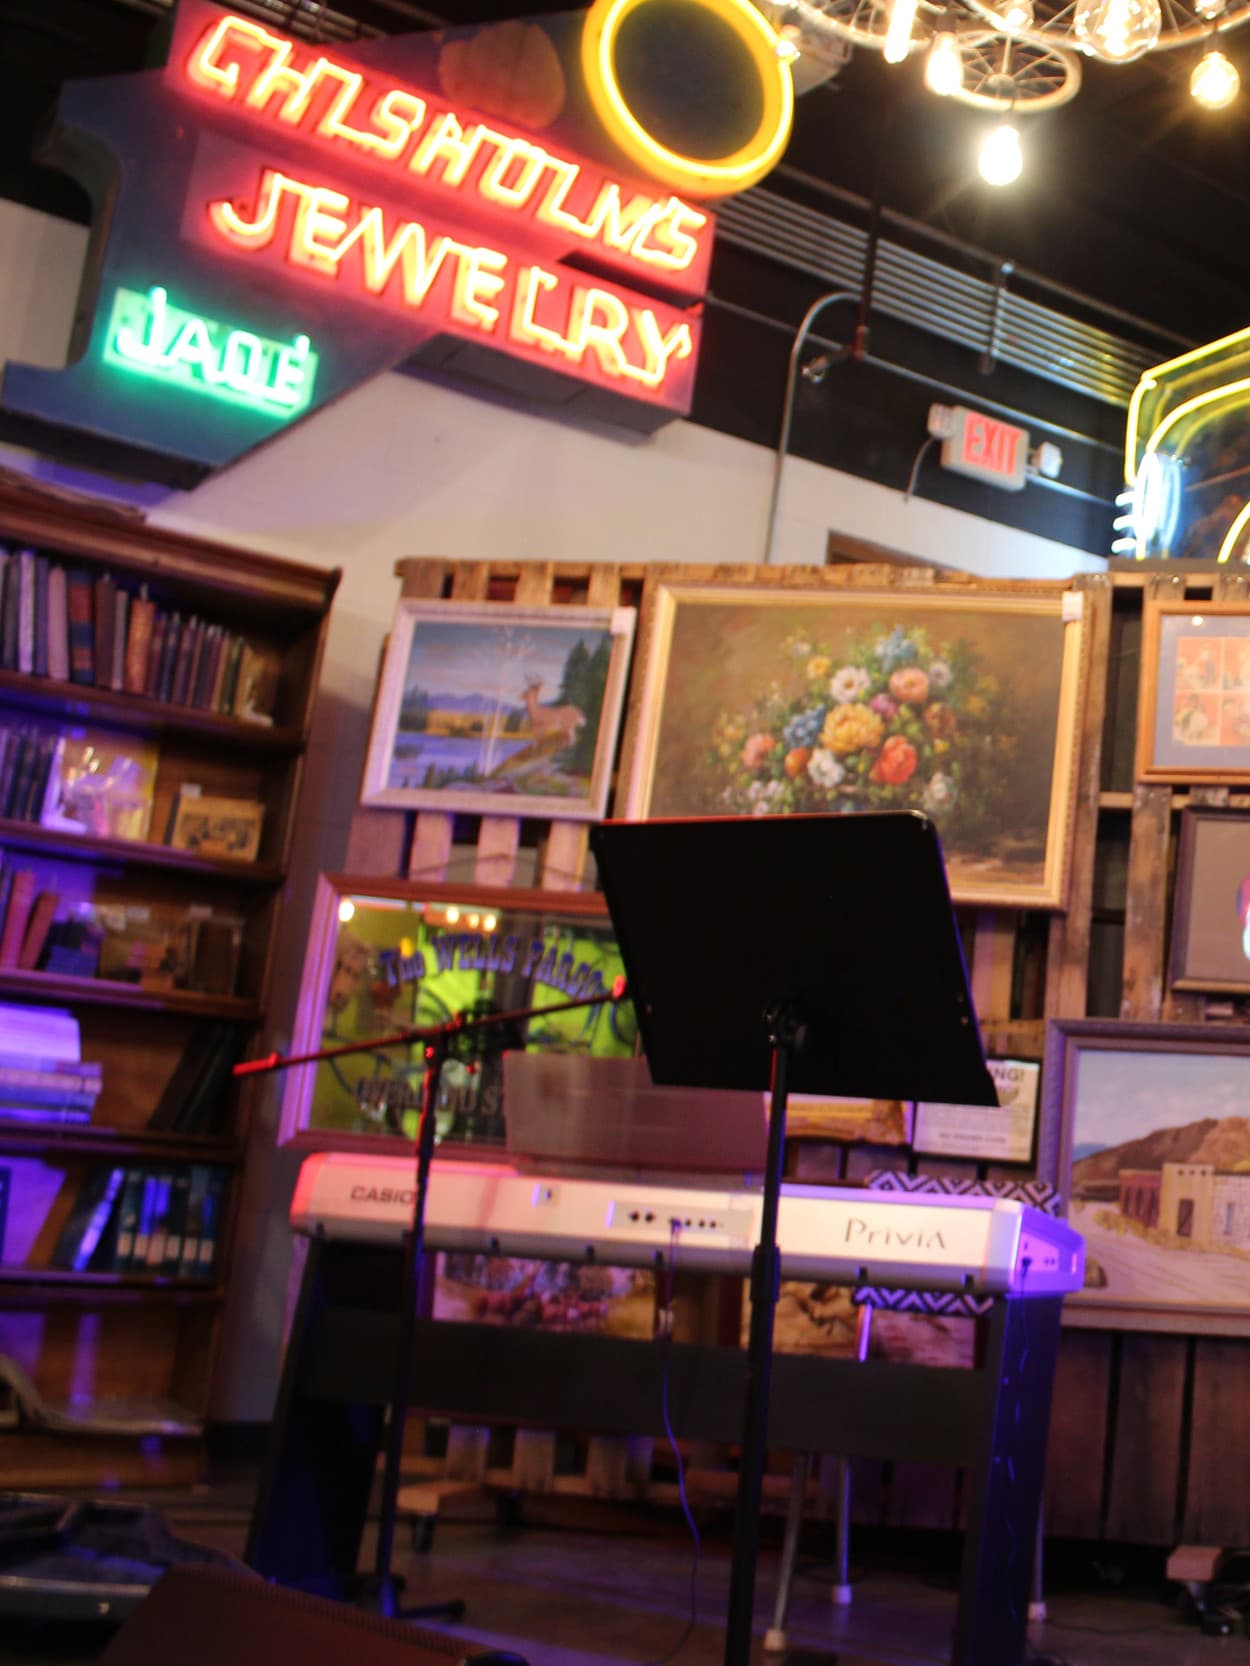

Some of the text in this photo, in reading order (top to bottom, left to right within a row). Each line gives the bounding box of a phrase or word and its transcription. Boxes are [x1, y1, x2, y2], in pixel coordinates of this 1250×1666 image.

[210, 171, 693, 387] JEWELRY
[963, 412, 1022, 477] EXIT
[431, 933, 518, 974] WELLS
[351, 1185, 417, 1206] CASIO
